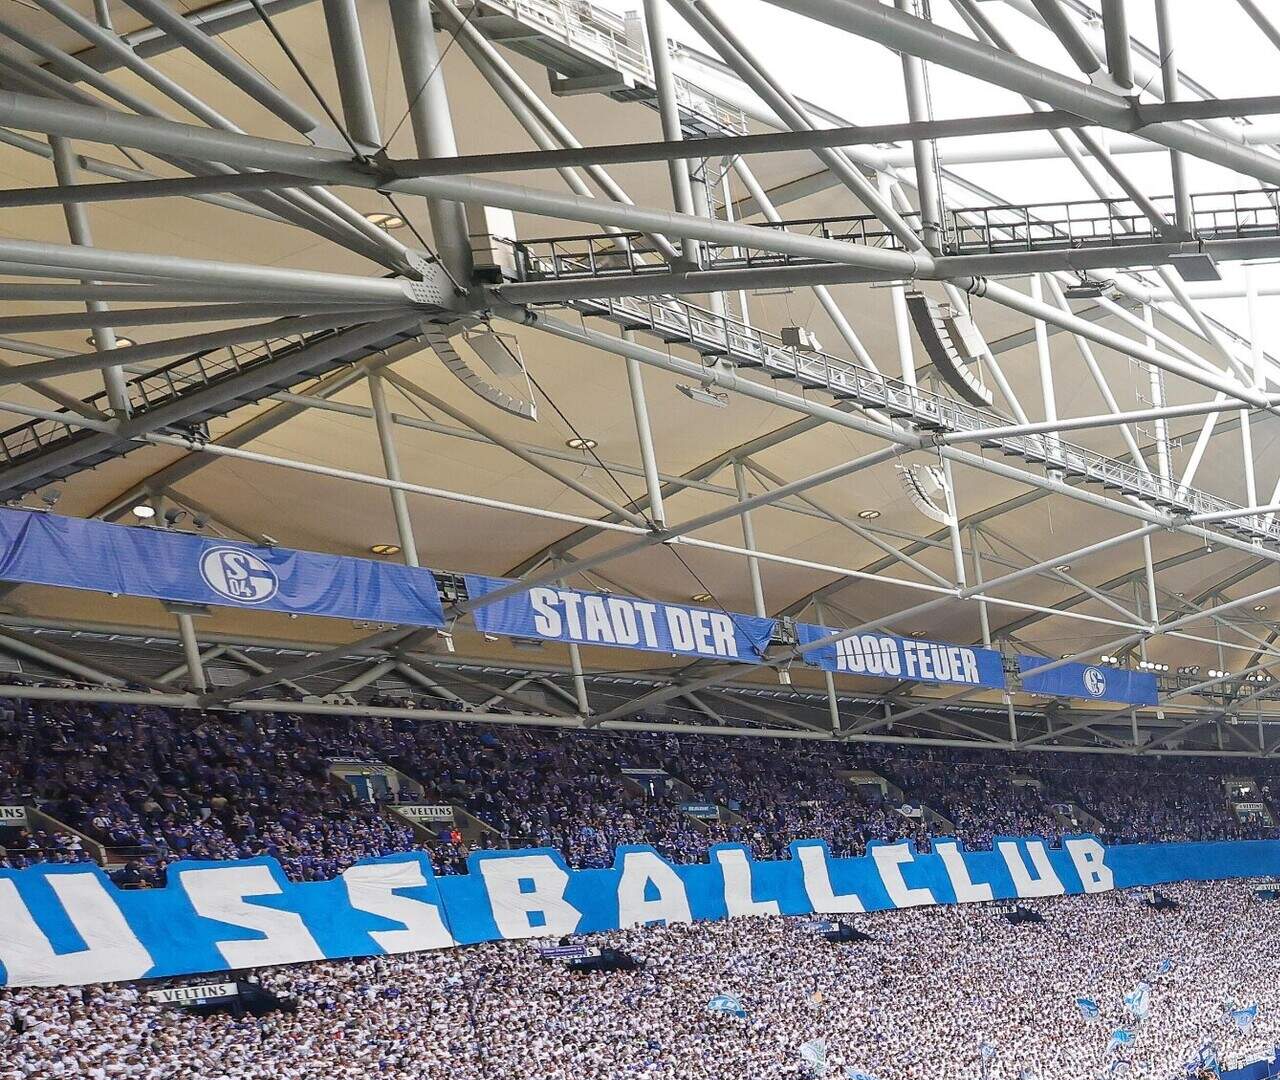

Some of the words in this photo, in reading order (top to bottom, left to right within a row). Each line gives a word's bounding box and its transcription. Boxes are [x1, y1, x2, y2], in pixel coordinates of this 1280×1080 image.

[529, 586, 660, 649] STADT
[678, 607, 738, 658] DER
[835, 631, 902, 675] 1000
[904, 641, 979, 683] FEUER
[410, 806, 453, 817] VELTINS
[163, 984, 228, 1001] VELTINS
